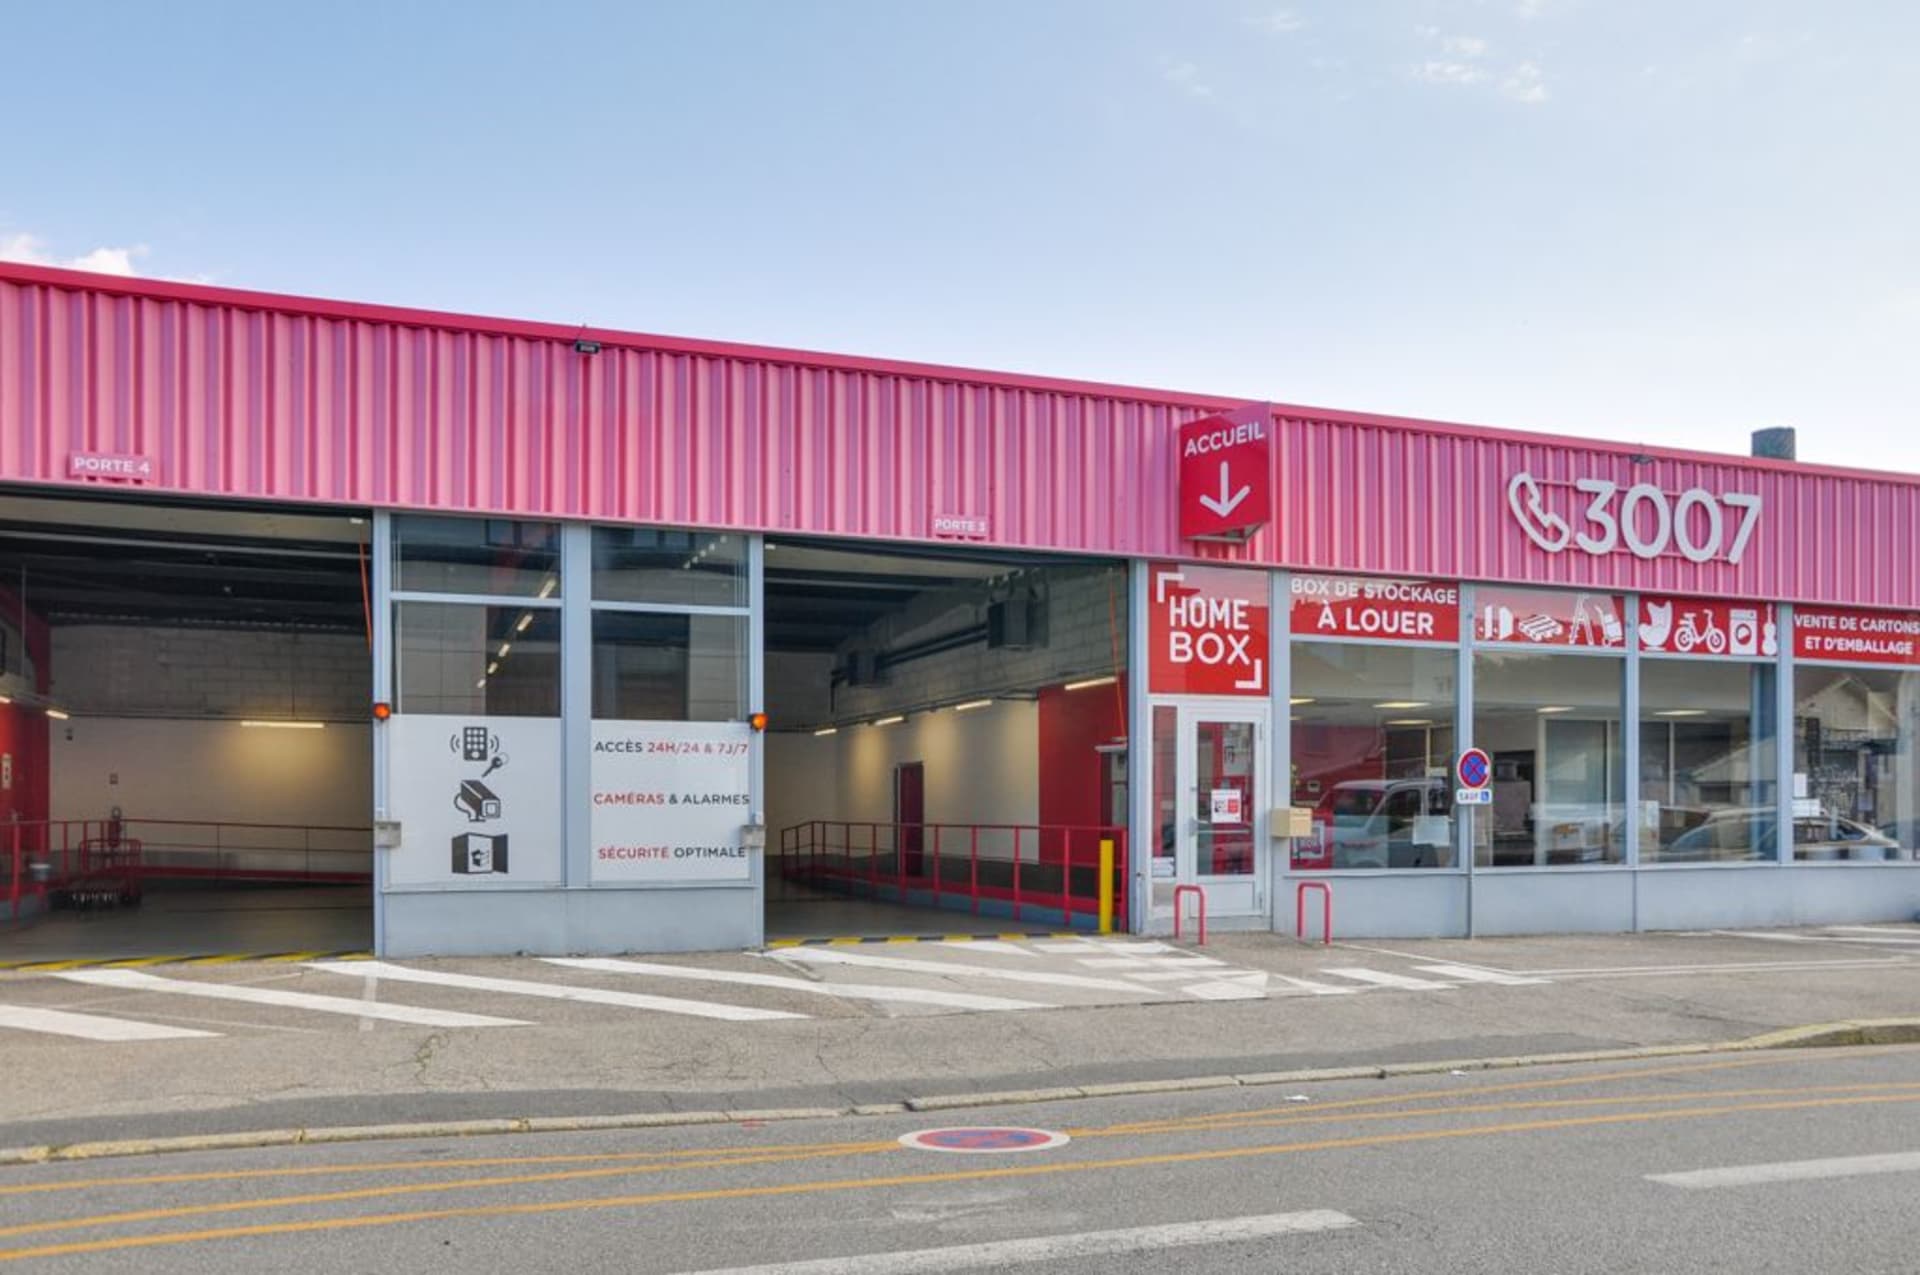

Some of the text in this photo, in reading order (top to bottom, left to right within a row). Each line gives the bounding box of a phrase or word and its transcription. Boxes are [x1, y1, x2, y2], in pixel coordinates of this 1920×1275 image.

[1184, 421, 1266, 457] ACCUEIL
[74, 457, 151, 475] PORTE 4
[934, 519, 986, 532] PORTE 3
[1576, 479, 1762, 564] 3007
[1291, 577, 1457, 604] BOX DE STOCKAGE
[1169, 595, 1250, 630] HOME
[1317, 601, 1434, 635] À LOUER
[1794, 613, 1920, 634] VENTE DE CARTONS
[1169, 631, 1250, 665] BOX
[1805, 636, 1912, 655] ET D'EMBALLAGE
[595, 740, 748, 756] ACCÈS 24H/24 & 7J/7
[594, 792, 750, 805] CAMÉRAS & ALARMES
[598, 846, 746, 859] SÉCURITÉ OPTIMALE
